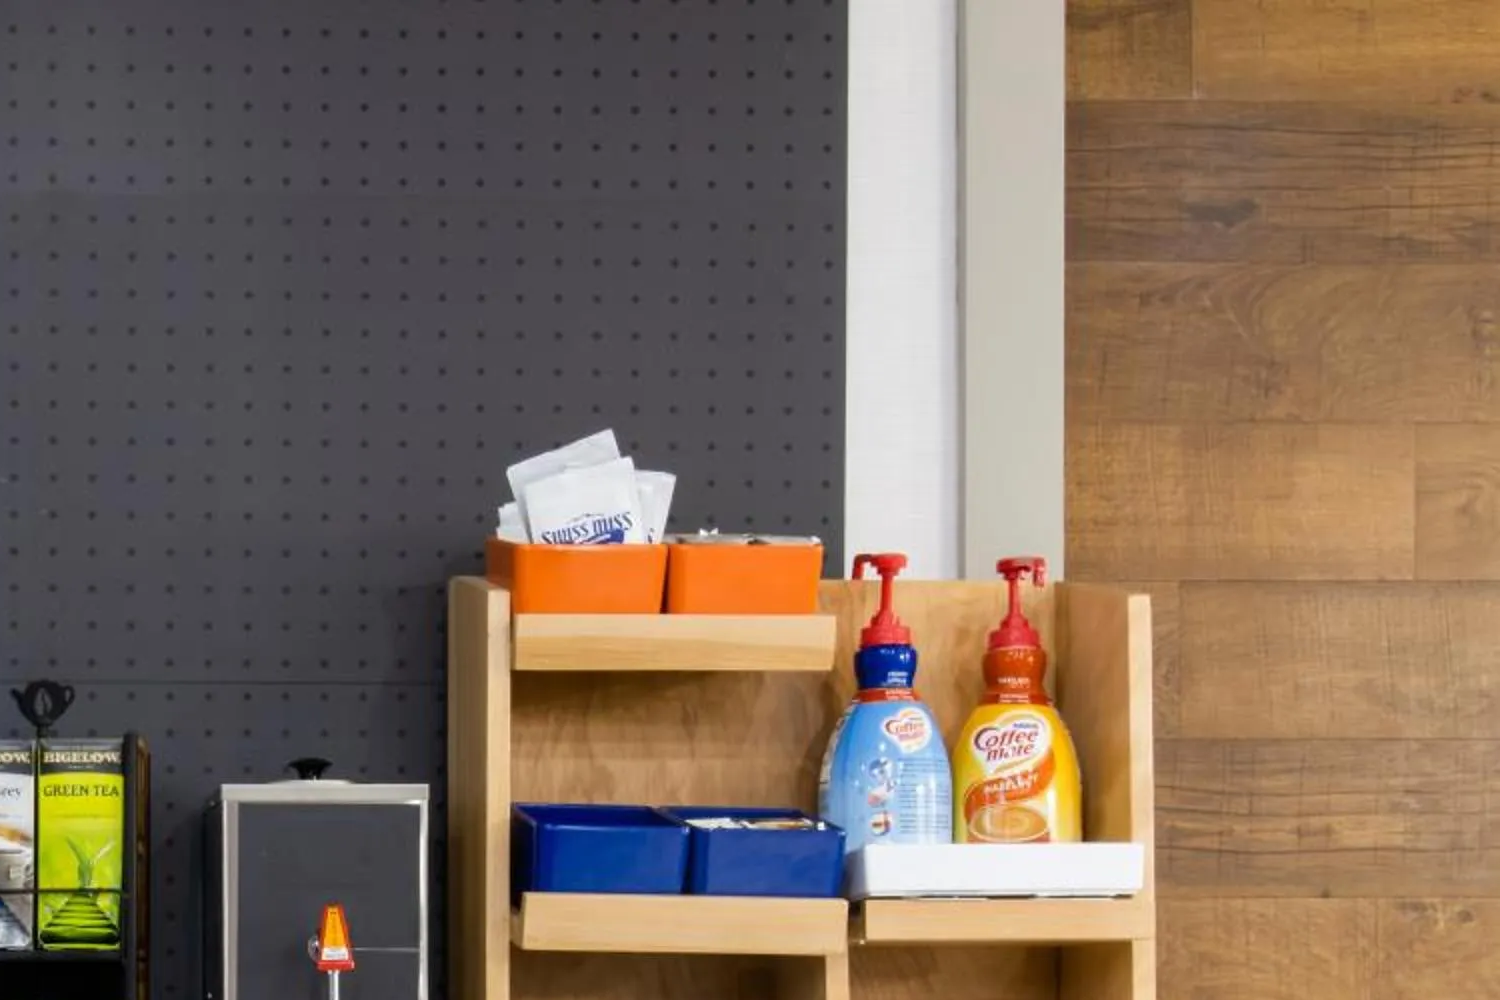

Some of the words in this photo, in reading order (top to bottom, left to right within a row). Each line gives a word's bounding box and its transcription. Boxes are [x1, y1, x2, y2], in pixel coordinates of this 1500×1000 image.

[974, 727, 1039, 752] Coffee
[43, 752, 120, 764] BIGELOW
[43, 785, 89, 798] GREEN
[93, 784, 119, 797] TEA
